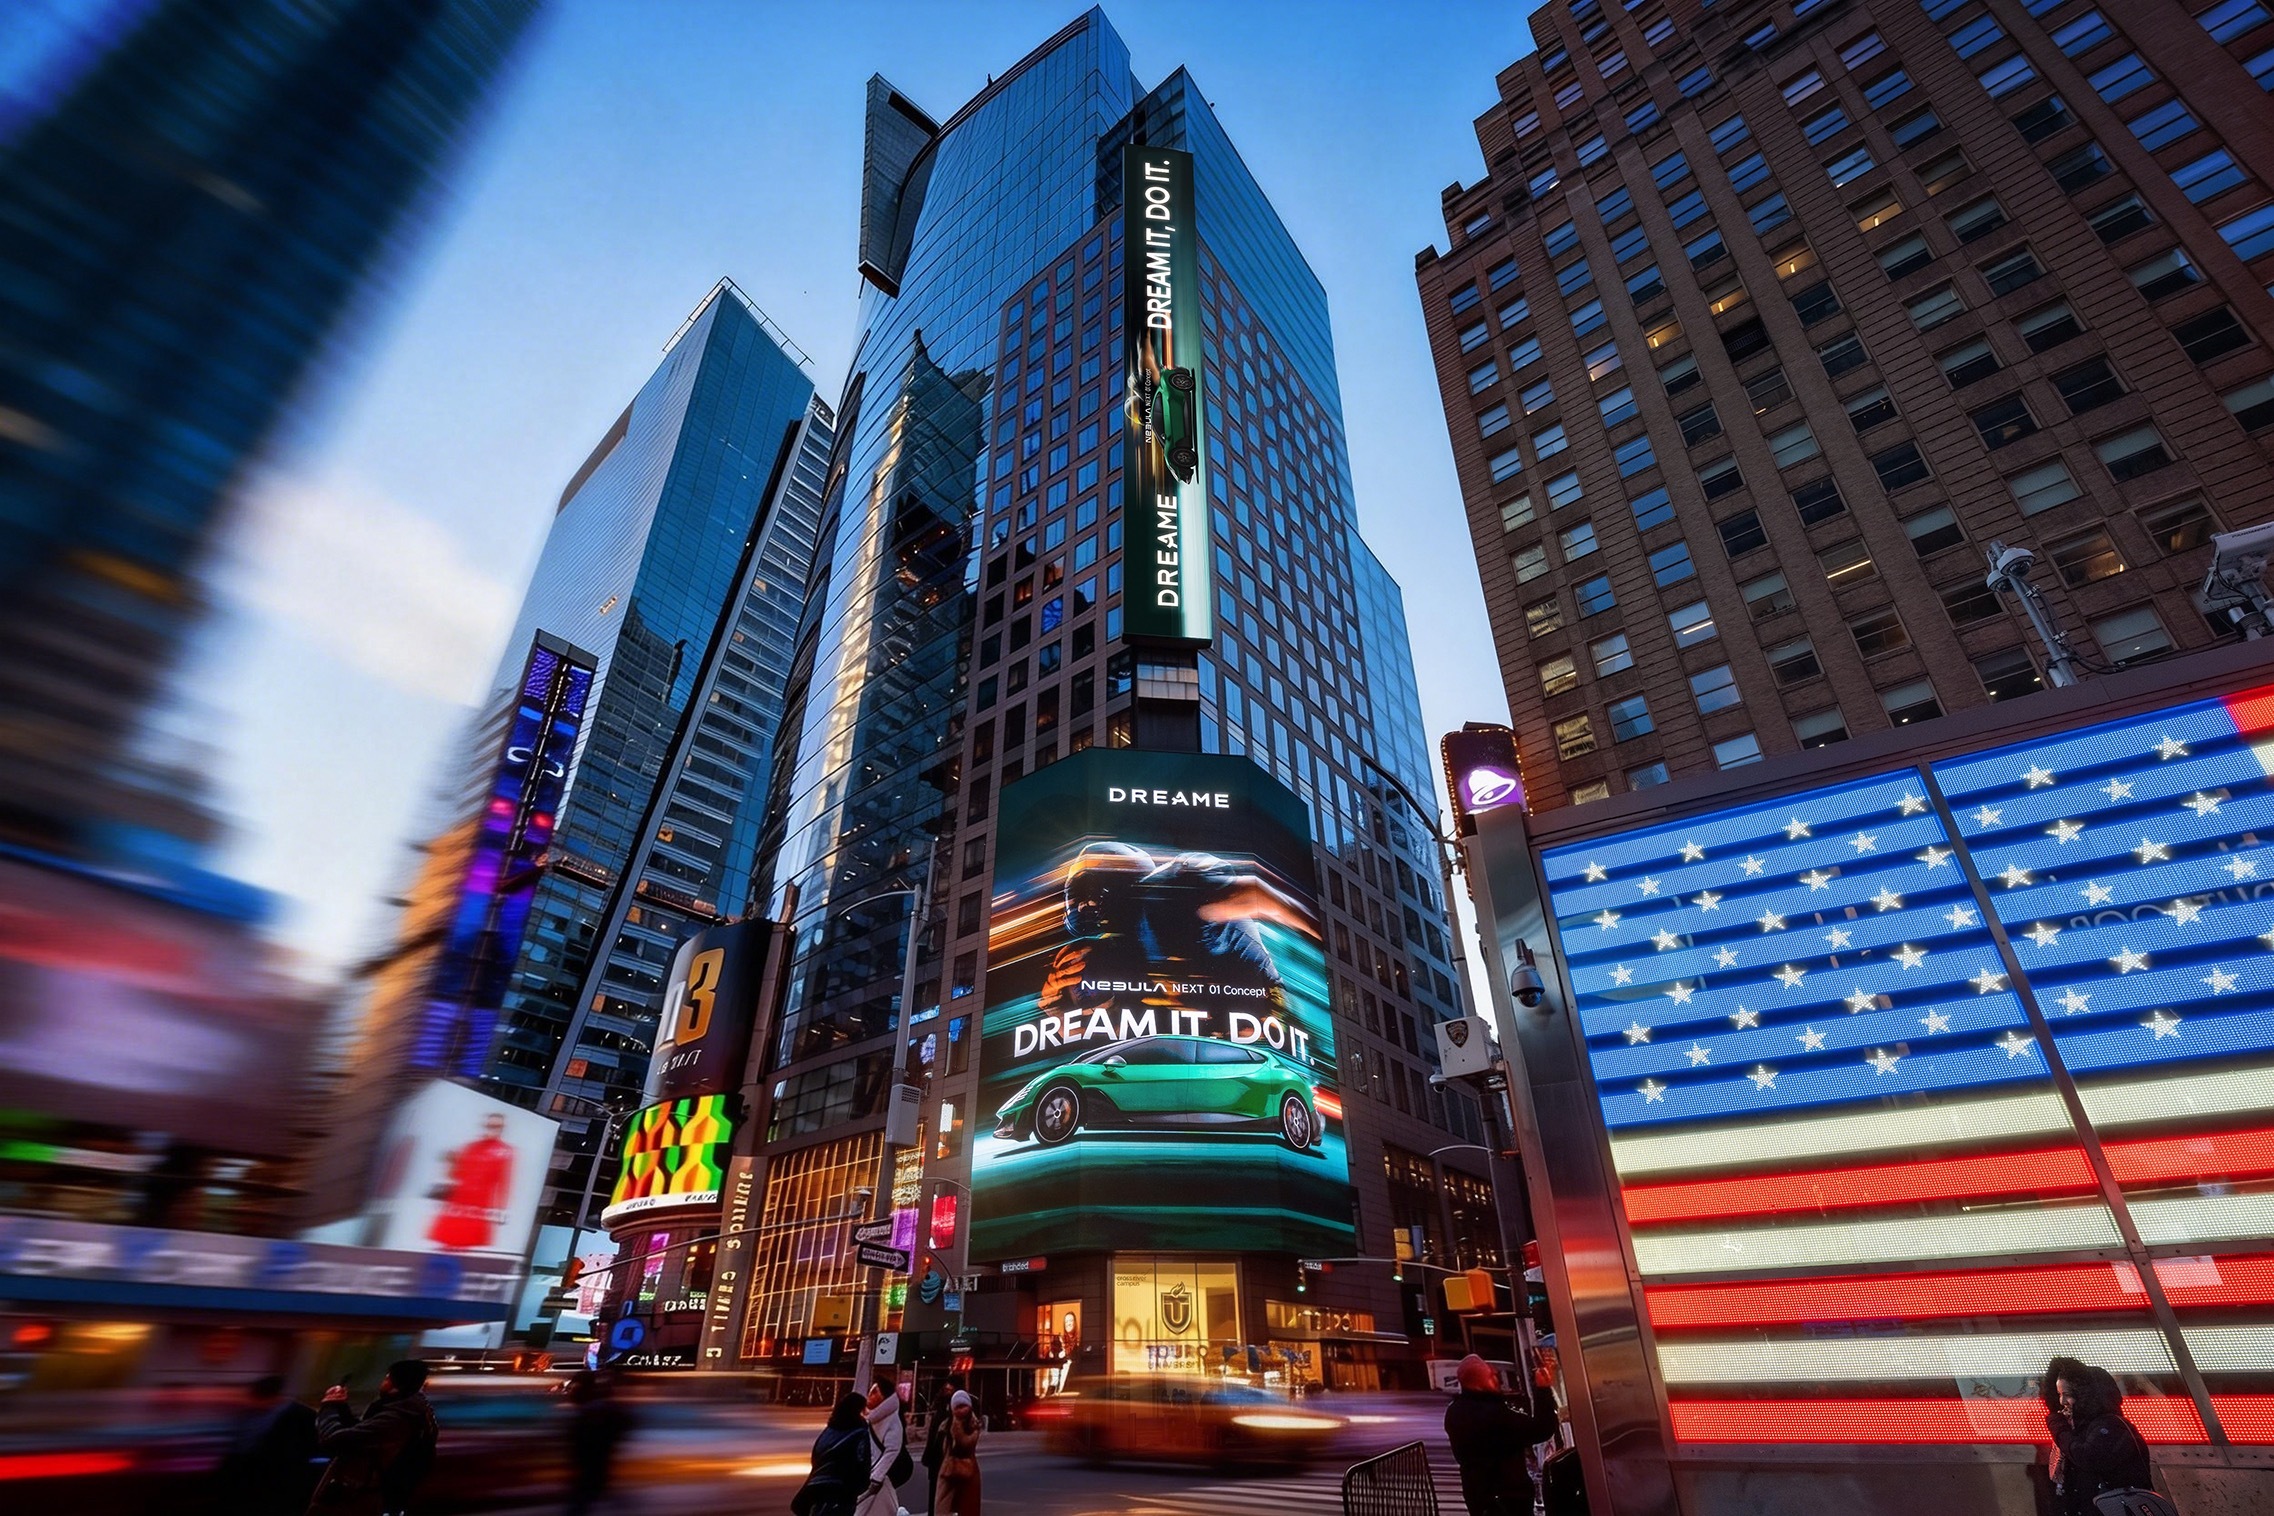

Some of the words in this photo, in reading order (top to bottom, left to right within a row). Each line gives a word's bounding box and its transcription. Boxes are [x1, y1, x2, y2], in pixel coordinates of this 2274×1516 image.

[1144, 160, 1170, 182] IT.
[1145, 186, 1171, 221] DO
[1145, 226, 1176, 247] IT,
[1146, 252, 1172, 329] DREAM
[1157, 493, 1180, 608] DREAME
[1108, 787, 1230, 809] DREAME
[1172, 984, 1204, 994] NEXT
[1209, 984, 1221, 995] 01
[1223, 985, 1267, 998] Concept
[1014, 1008, 1157, 1058] DREAM
[1229, 1011, 1286, 1050] DO
[1289, 1025, 1316, 1066] IT.
[1146, 1344, 1208, 1360] TOURO
